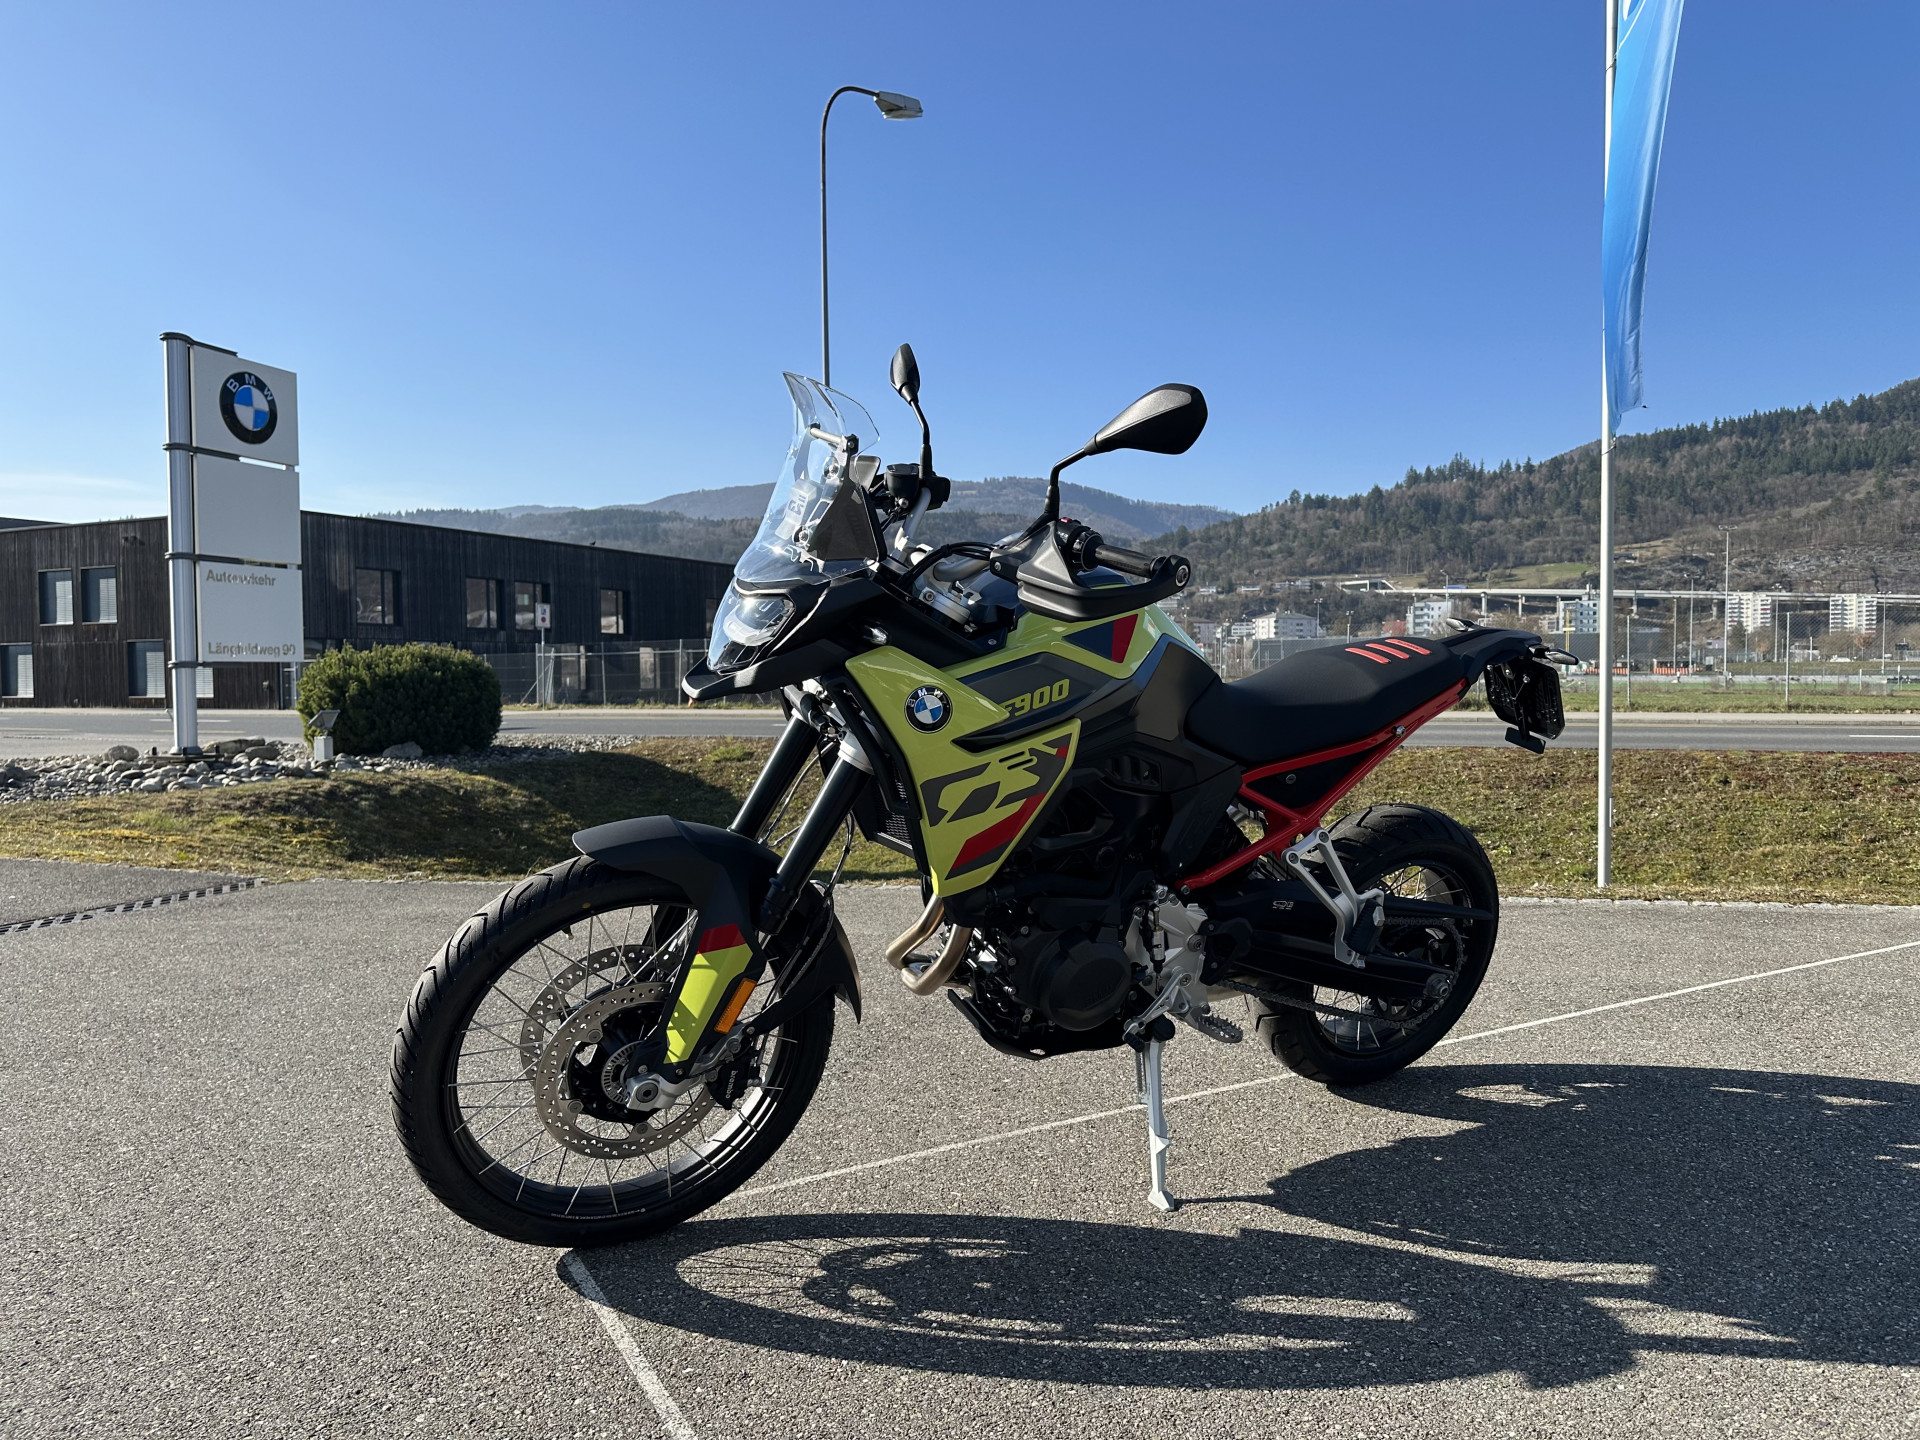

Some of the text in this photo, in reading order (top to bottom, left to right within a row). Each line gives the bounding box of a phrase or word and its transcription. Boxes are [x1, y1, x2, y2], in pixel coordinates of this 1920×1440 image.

[226, 373, 274, 401] BMW
[907, 687, 943, 708] BMW
[725, 1070, 738, 1099] brembo
